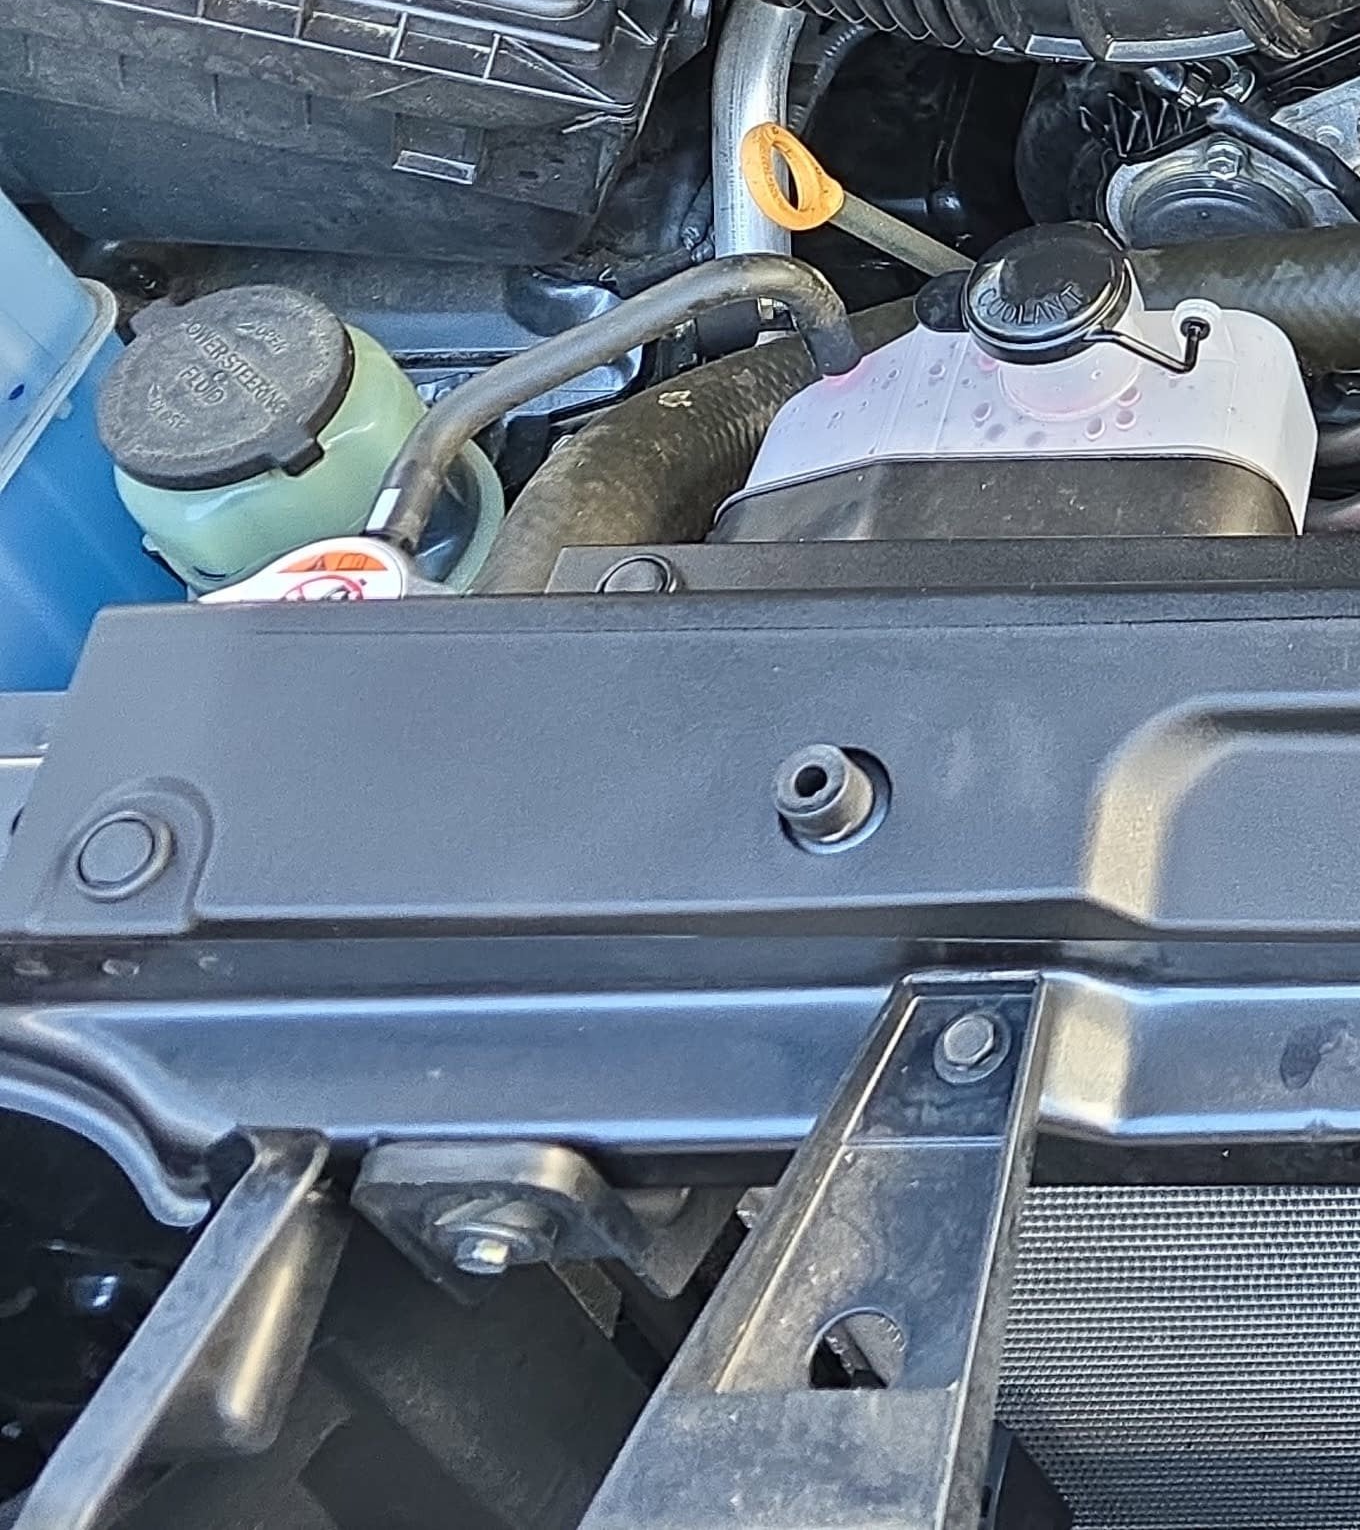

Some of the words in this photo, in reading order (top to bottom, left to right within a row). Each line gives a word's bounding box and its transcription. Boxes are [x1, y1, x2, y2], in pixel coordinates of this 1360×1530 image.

[977, 283, 1084, 326] COOLANT
[179, 365, 228, 406] FLUID
[221, 350, 292, 416] STEERING
